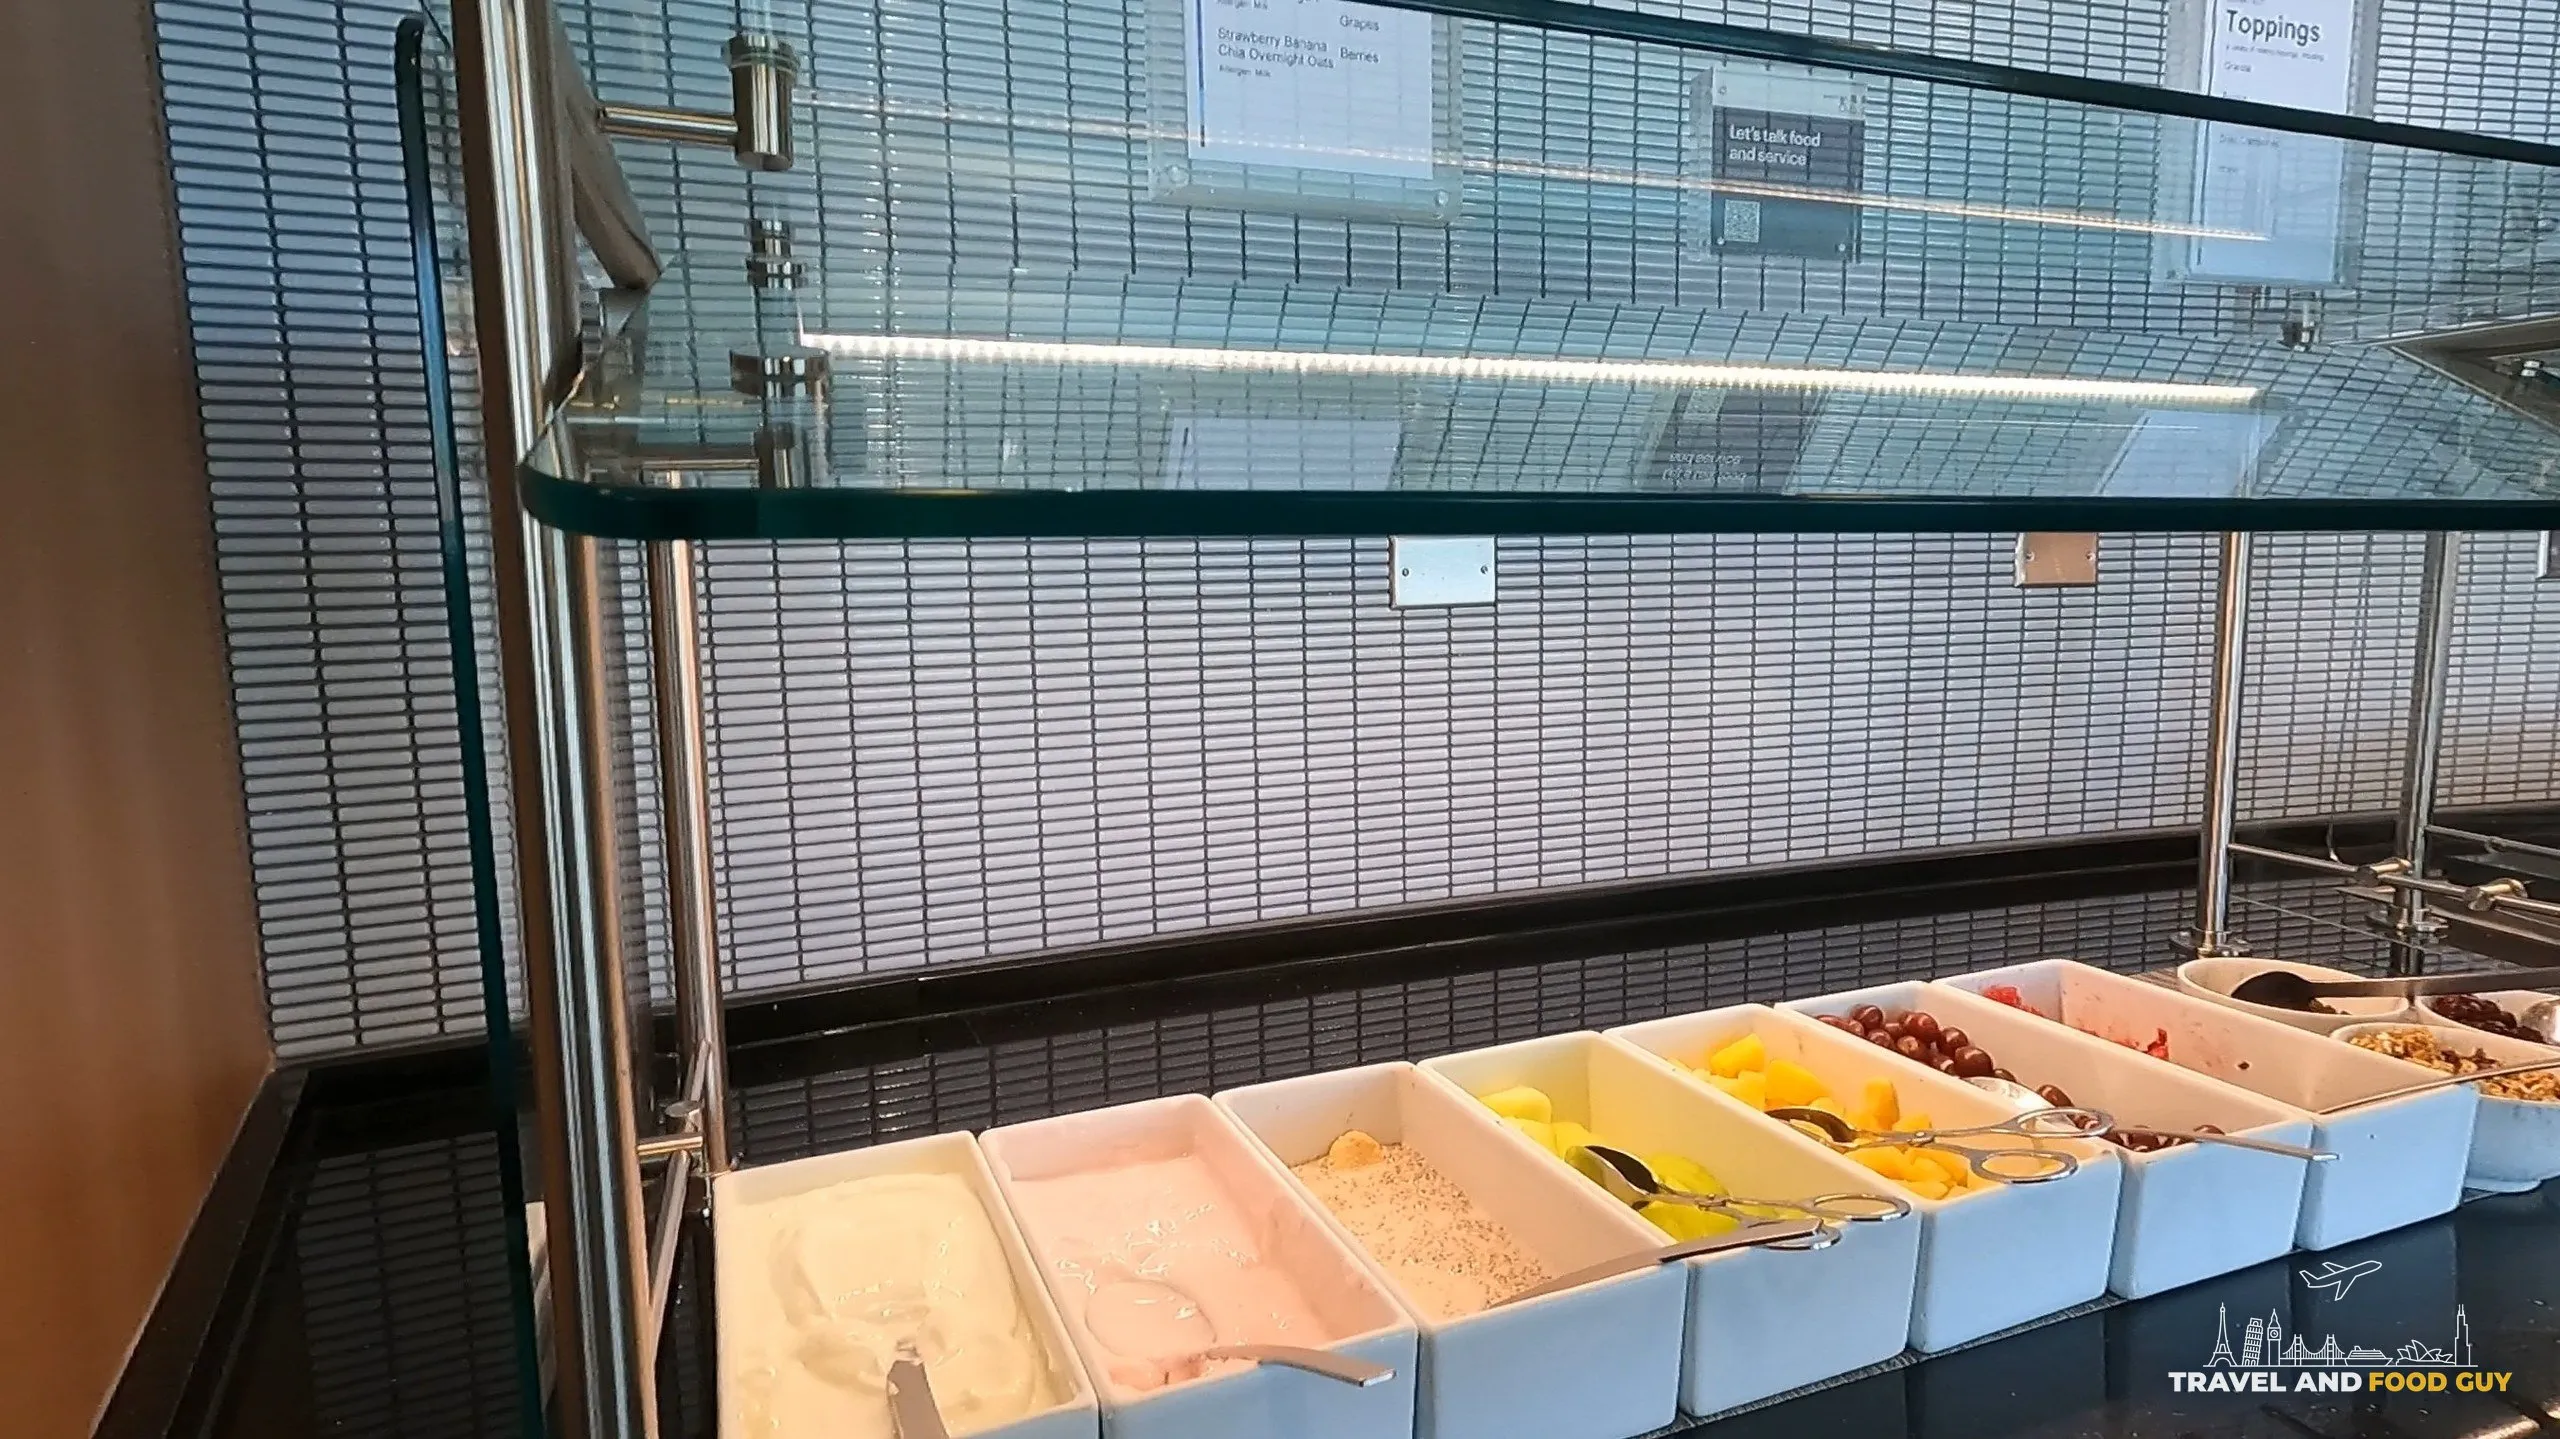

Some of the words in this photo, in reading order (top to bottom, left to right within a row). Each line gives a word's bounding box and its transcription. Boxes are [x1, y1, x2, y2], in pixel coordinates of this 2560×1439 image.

[1339, 14, 1380, 32] Grapes
[2226, 9, 2321, 46] Toppings
[1217, 27, 1281, 48] Strawberry
[1284, 35, 1328, 52] Banana
[1218, 43, 1246, 59] Chia
[1249, 48, 1305, 67] Overnight
[1308, 56, 1335, 69] Oats
[1339, 47, 1380, 64] Berries
[1729, 124, 1761, 142] Let's
[1763, 127, 1787, 144] talk
[1789, 129, 1822, 147] food
[1729, 147, 1756, 162] and
[1758, 151, 1808, 166] service
